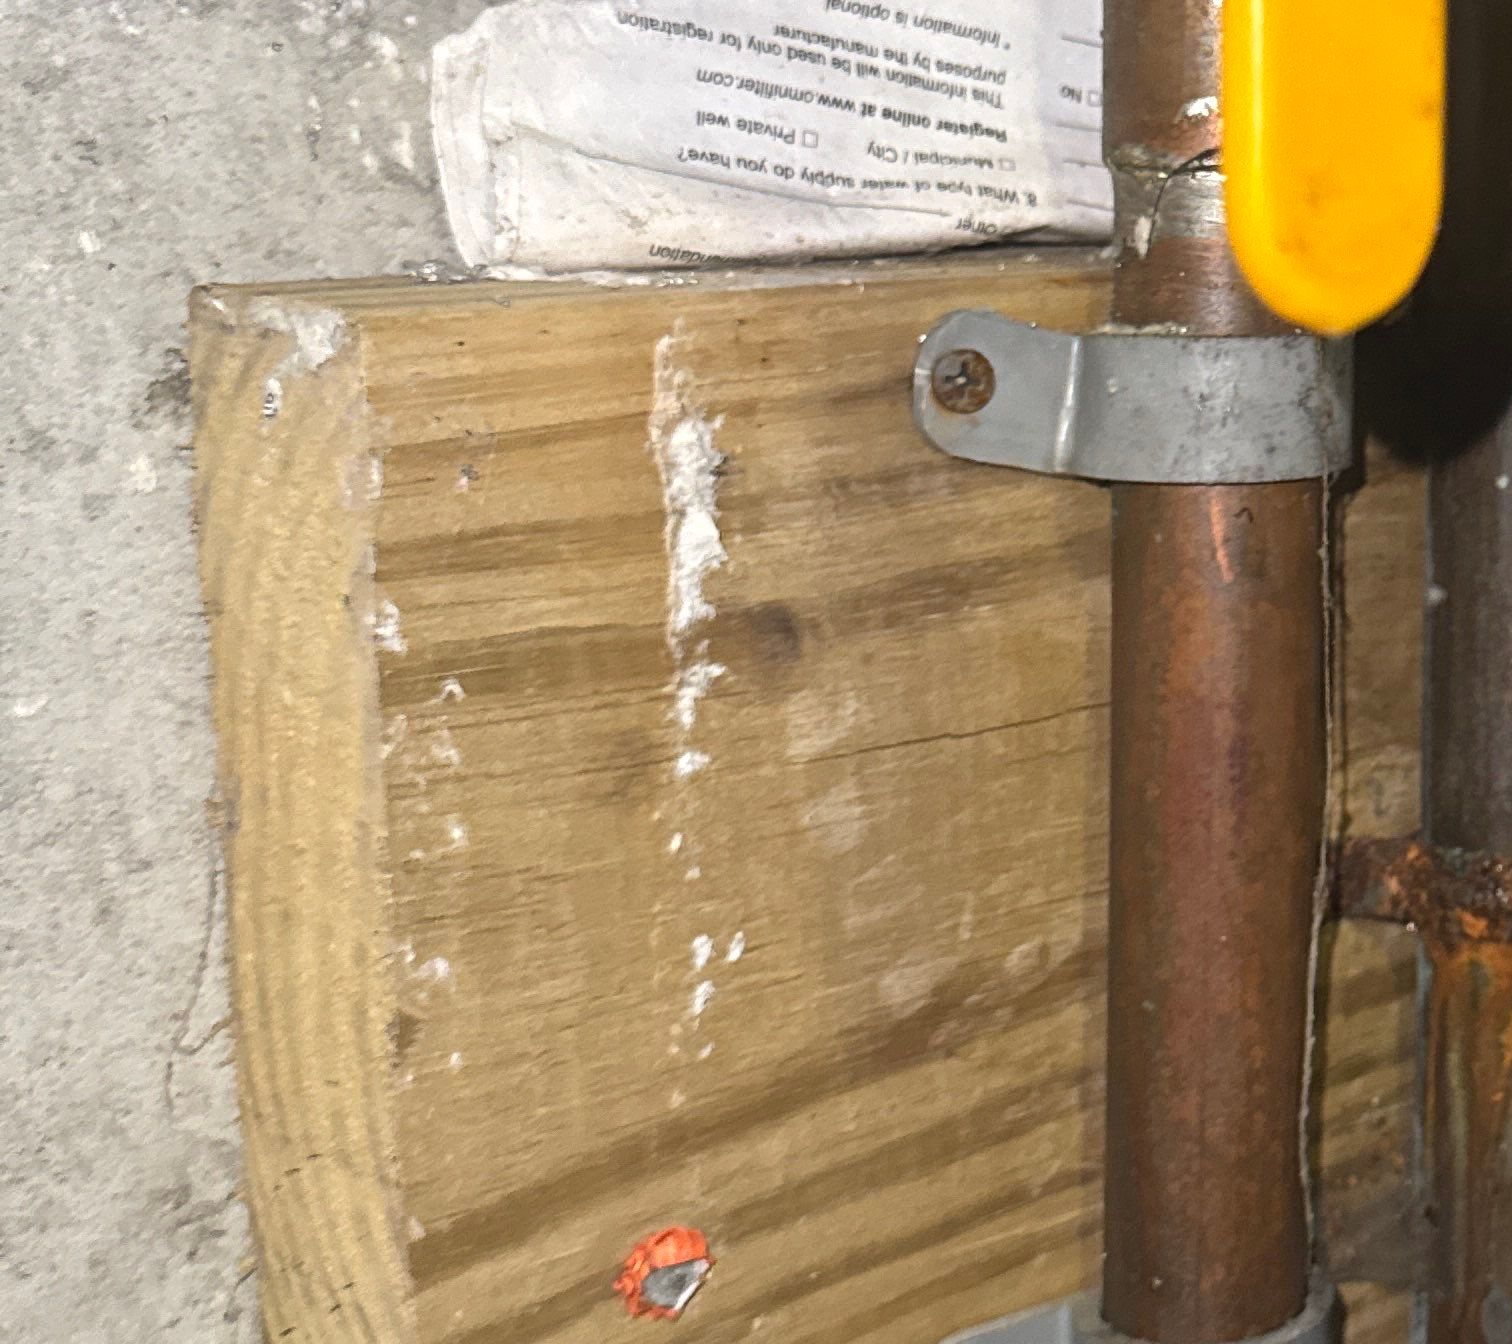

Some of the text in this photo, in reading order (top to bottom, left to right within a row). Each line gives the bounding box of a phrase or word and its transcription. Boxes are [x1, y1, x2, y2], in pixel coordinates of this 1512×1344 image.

[895, 11, 908, 30] is
[913, 15, 1000, 49] Information
[616, 11, 1003, 109] This information will be used only for registration
[773, 25, 1006, 86] purposes by the manufacturer
[696, 69, 1007, 144] Register online at www.omnifilter.com
[696, 110, 796, 145] Private well
[677, 147, 730, 169] have?
[867, 140, 898, 163] City
[914, 151, 994, 170] Municipal
[737, 157, 768, 173] you
[773, 164, 795, 181] do
[801, 167, 855, 191] supply
[860, 179, 908, 193] water
[914, 181, 931, 194] of
[937, 181, 972, 197] type
[978, 186, 1018, 205] What
